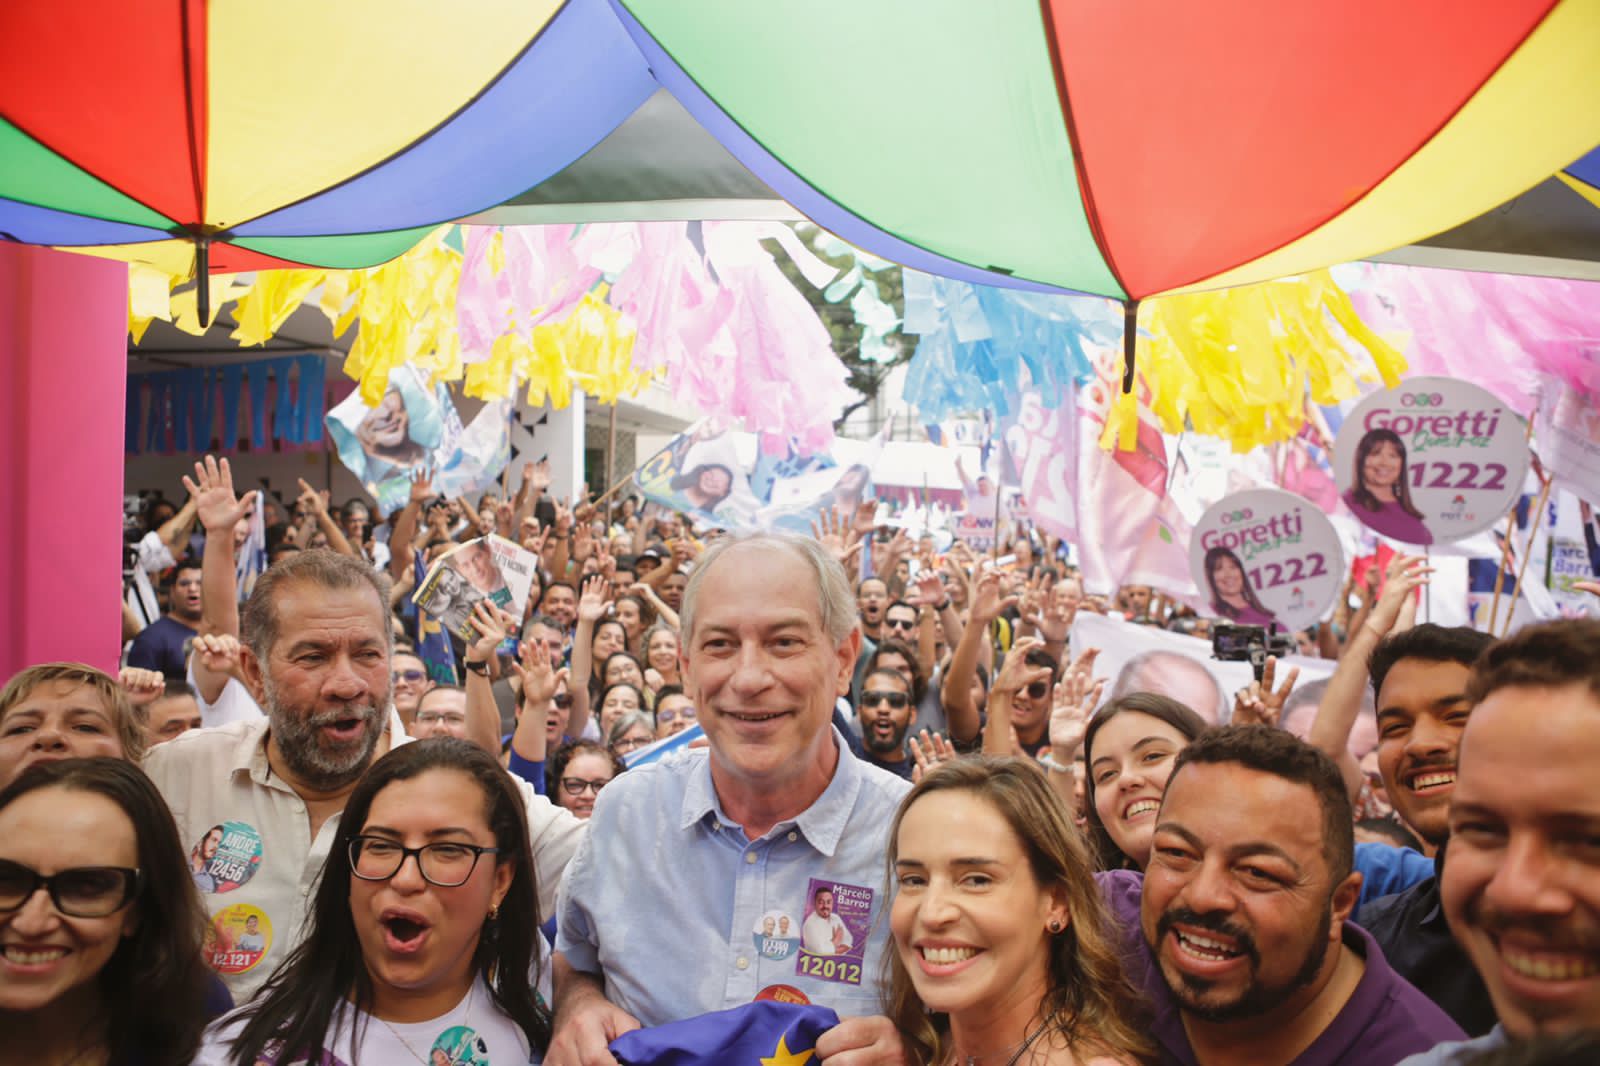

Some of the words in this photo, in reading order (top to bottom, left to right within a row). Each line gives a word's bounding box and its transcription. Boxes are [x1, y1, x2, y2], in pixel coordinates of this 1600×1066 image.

[1363, 407, 1503, 438] Goretti
[1408, 461, 1508, 491] 1222
[1200, 506, 1303, 552] Goretti
[1248, 551, 1329, 591] 1222
[832, 884, 872, 901] Marcelo
[837, 894, 870, 910] Barros
[799, 954, 861, 983] 12012
